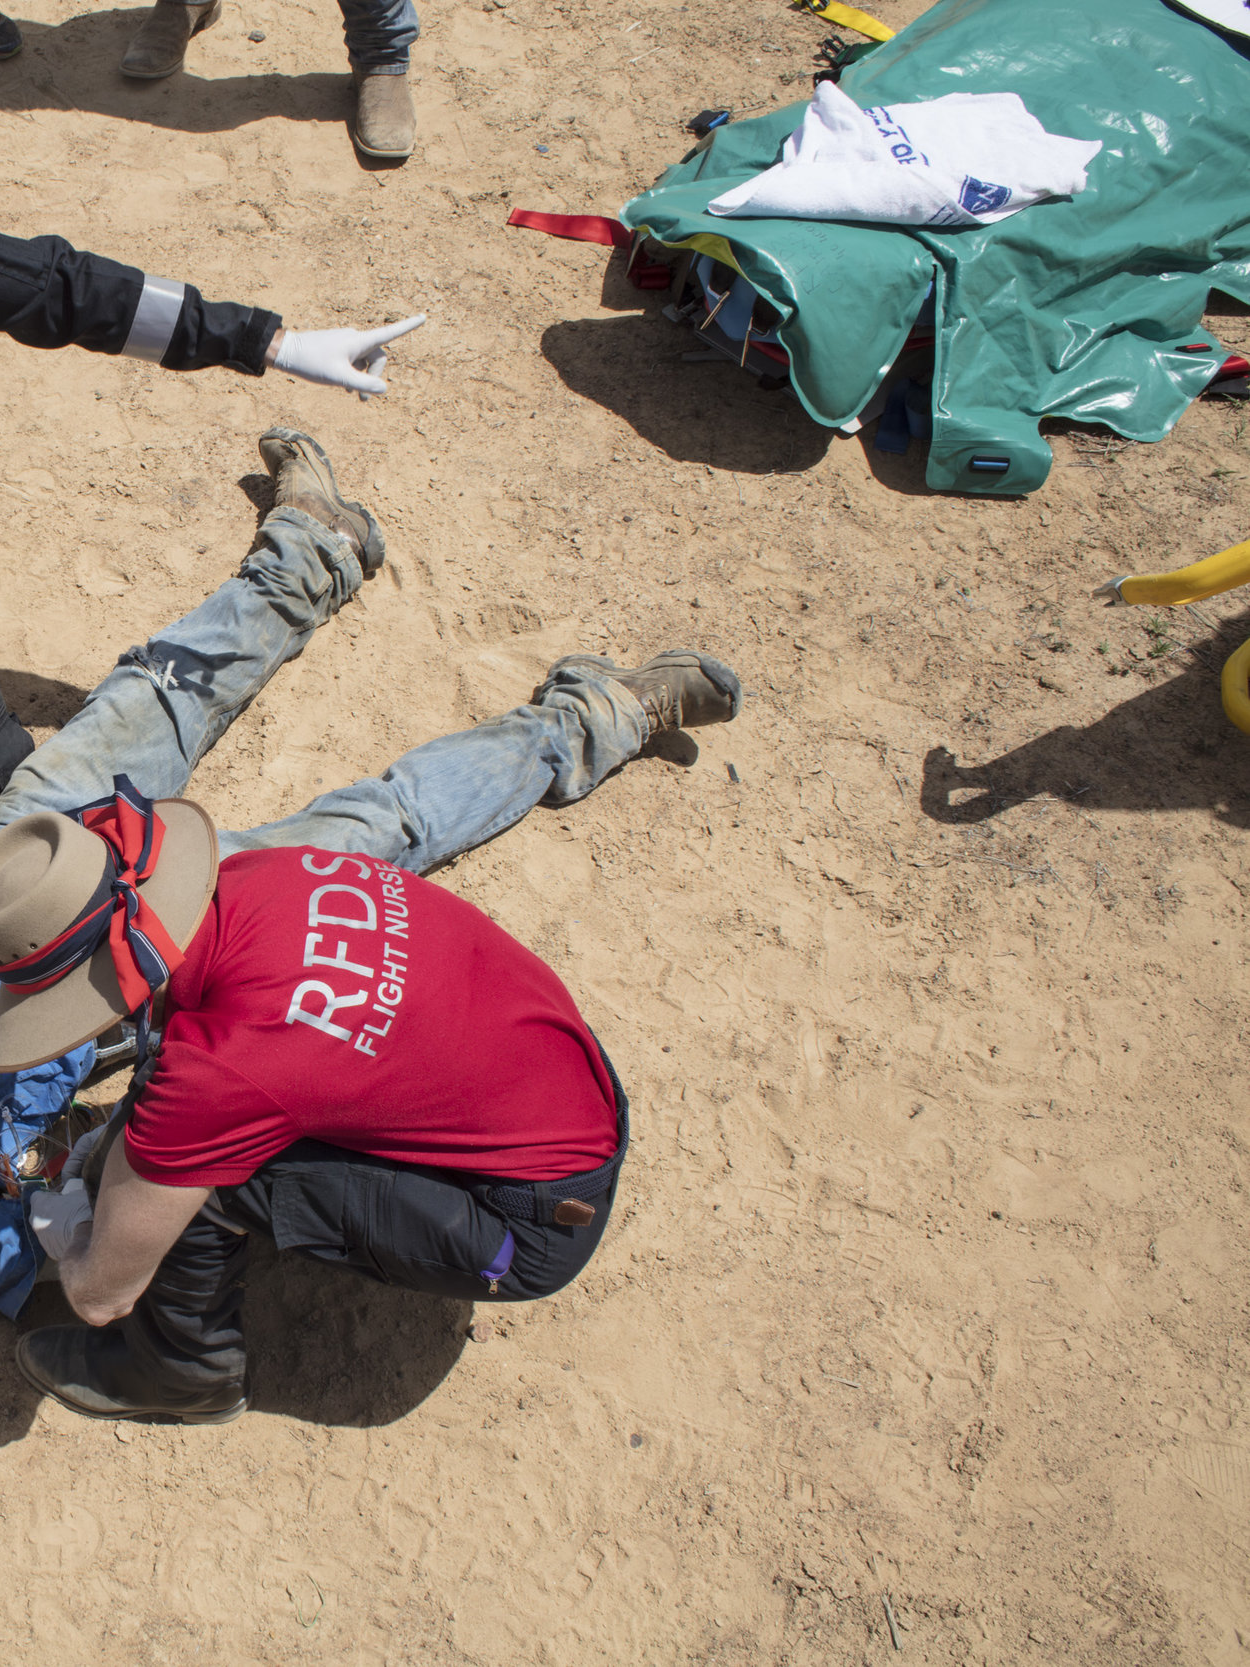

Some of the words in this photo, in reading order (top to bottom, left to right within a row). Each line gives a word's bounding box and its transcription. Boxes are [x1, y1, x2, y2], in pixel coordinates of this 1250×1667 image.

[285, 853, 377, 1042] RFDS
[374, 862, 410, 939] NURSE
[353, 942, 409, 1057] FLIGHT
